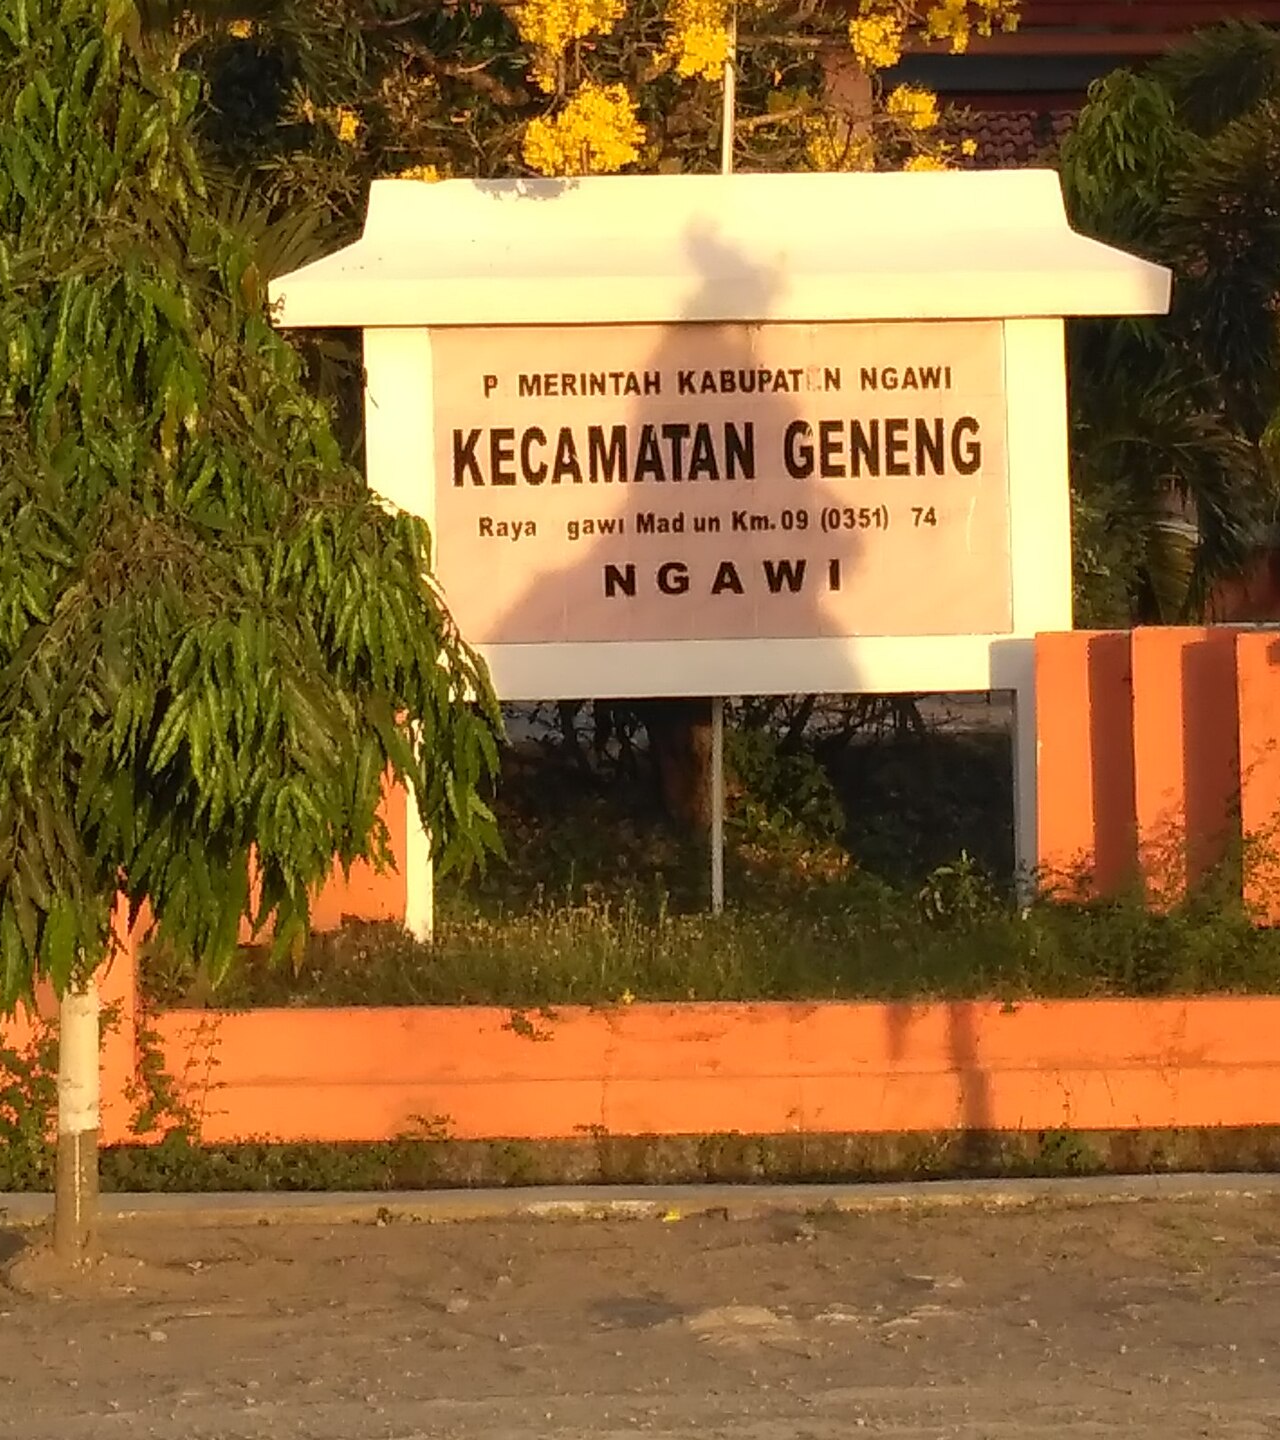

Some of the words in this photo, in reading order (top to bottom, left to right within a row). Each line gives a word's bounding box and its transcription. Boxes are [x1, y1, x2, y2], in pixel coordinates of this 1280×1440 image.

[482, 370, 661, 398] PMERINTAH
[860, 365, 952, 391] NGAWI
[452, 421, 755, 488] KECAMATAN
[783, 415, 982, 479] GENENG
[478, 516, 537, 542] Raya
[820, 504, 889, 533] (0351)
